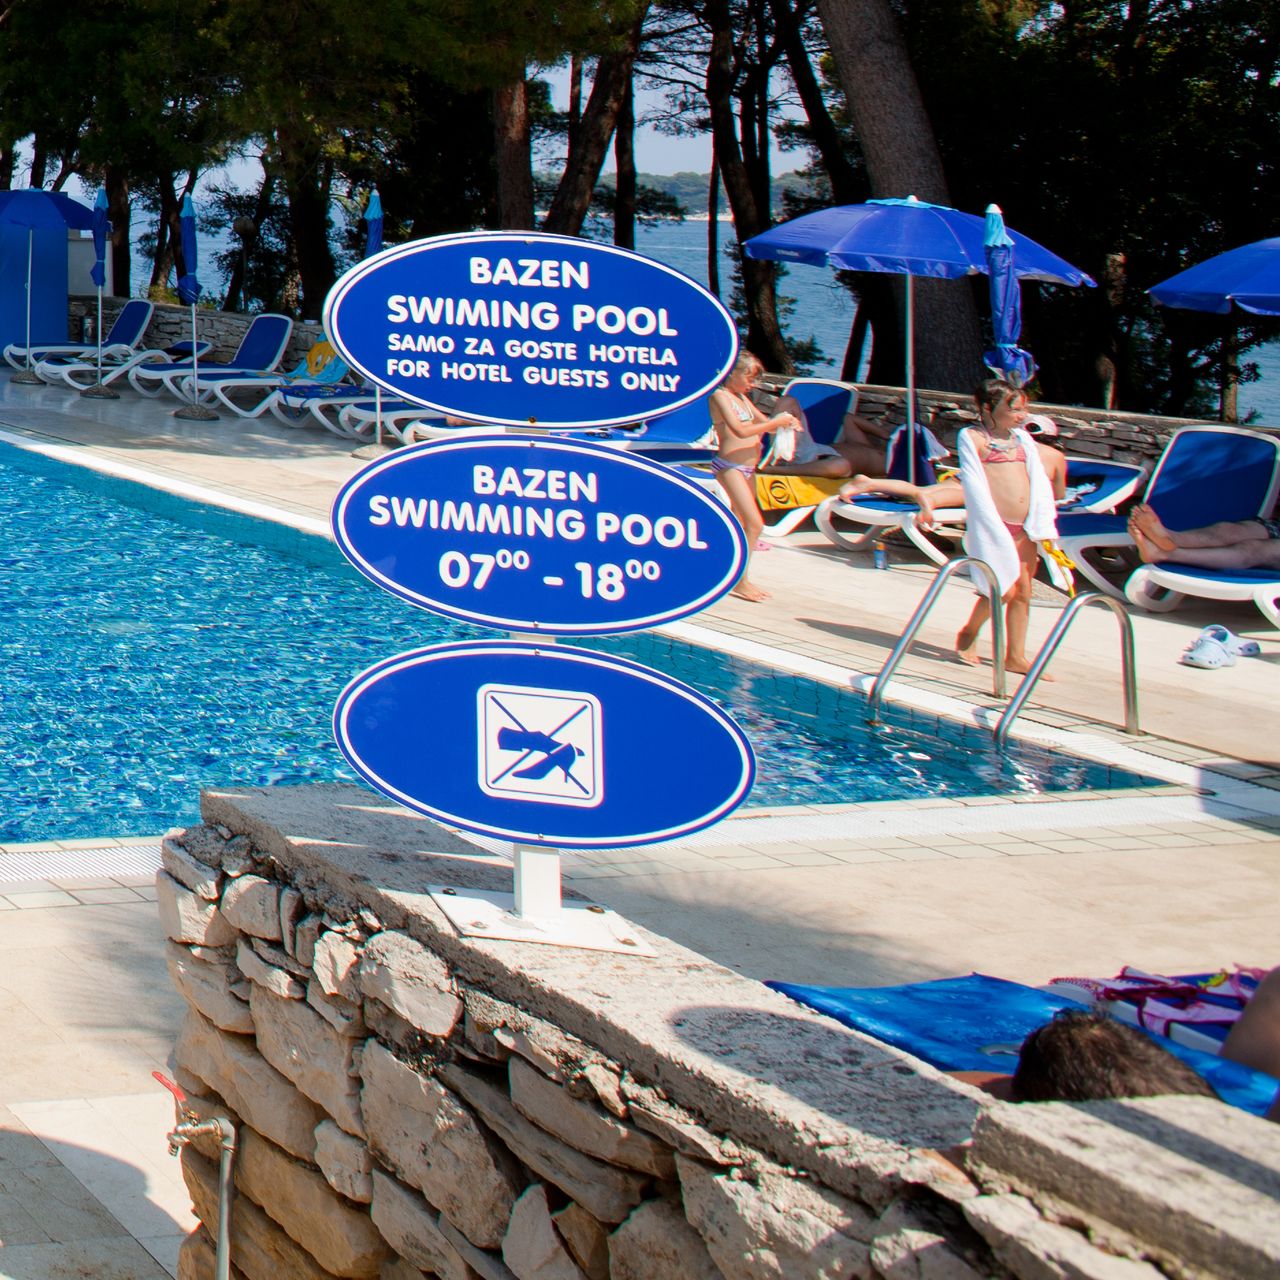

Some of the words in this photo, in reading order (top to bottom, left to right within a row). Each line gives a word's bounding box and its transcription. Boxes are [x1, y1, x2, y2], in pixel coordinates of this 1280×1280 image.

[469, 256, 590, 289] BAZEN
[387, 294, 560, 331] SWIMING
[573, 304, 678, 337] POOL
[387, 333, 455, 354] SAMO
[464, 337, 495, 357] ZA
[504, 339, 578, 361] GOSTE
[589, 344, 678, 366] HOTELA
[387, 358, 431, 379] FOR
[441, 361, 512, 383] HOTEL
[522, 366, 610, 389] GUESTS
[621, 371, 681, 393] ONLY
[473, 464, 598, 503] BAZEN
[369, 495, 586, 541] SWIMMING
[596, 512, 708, 550] POOL
